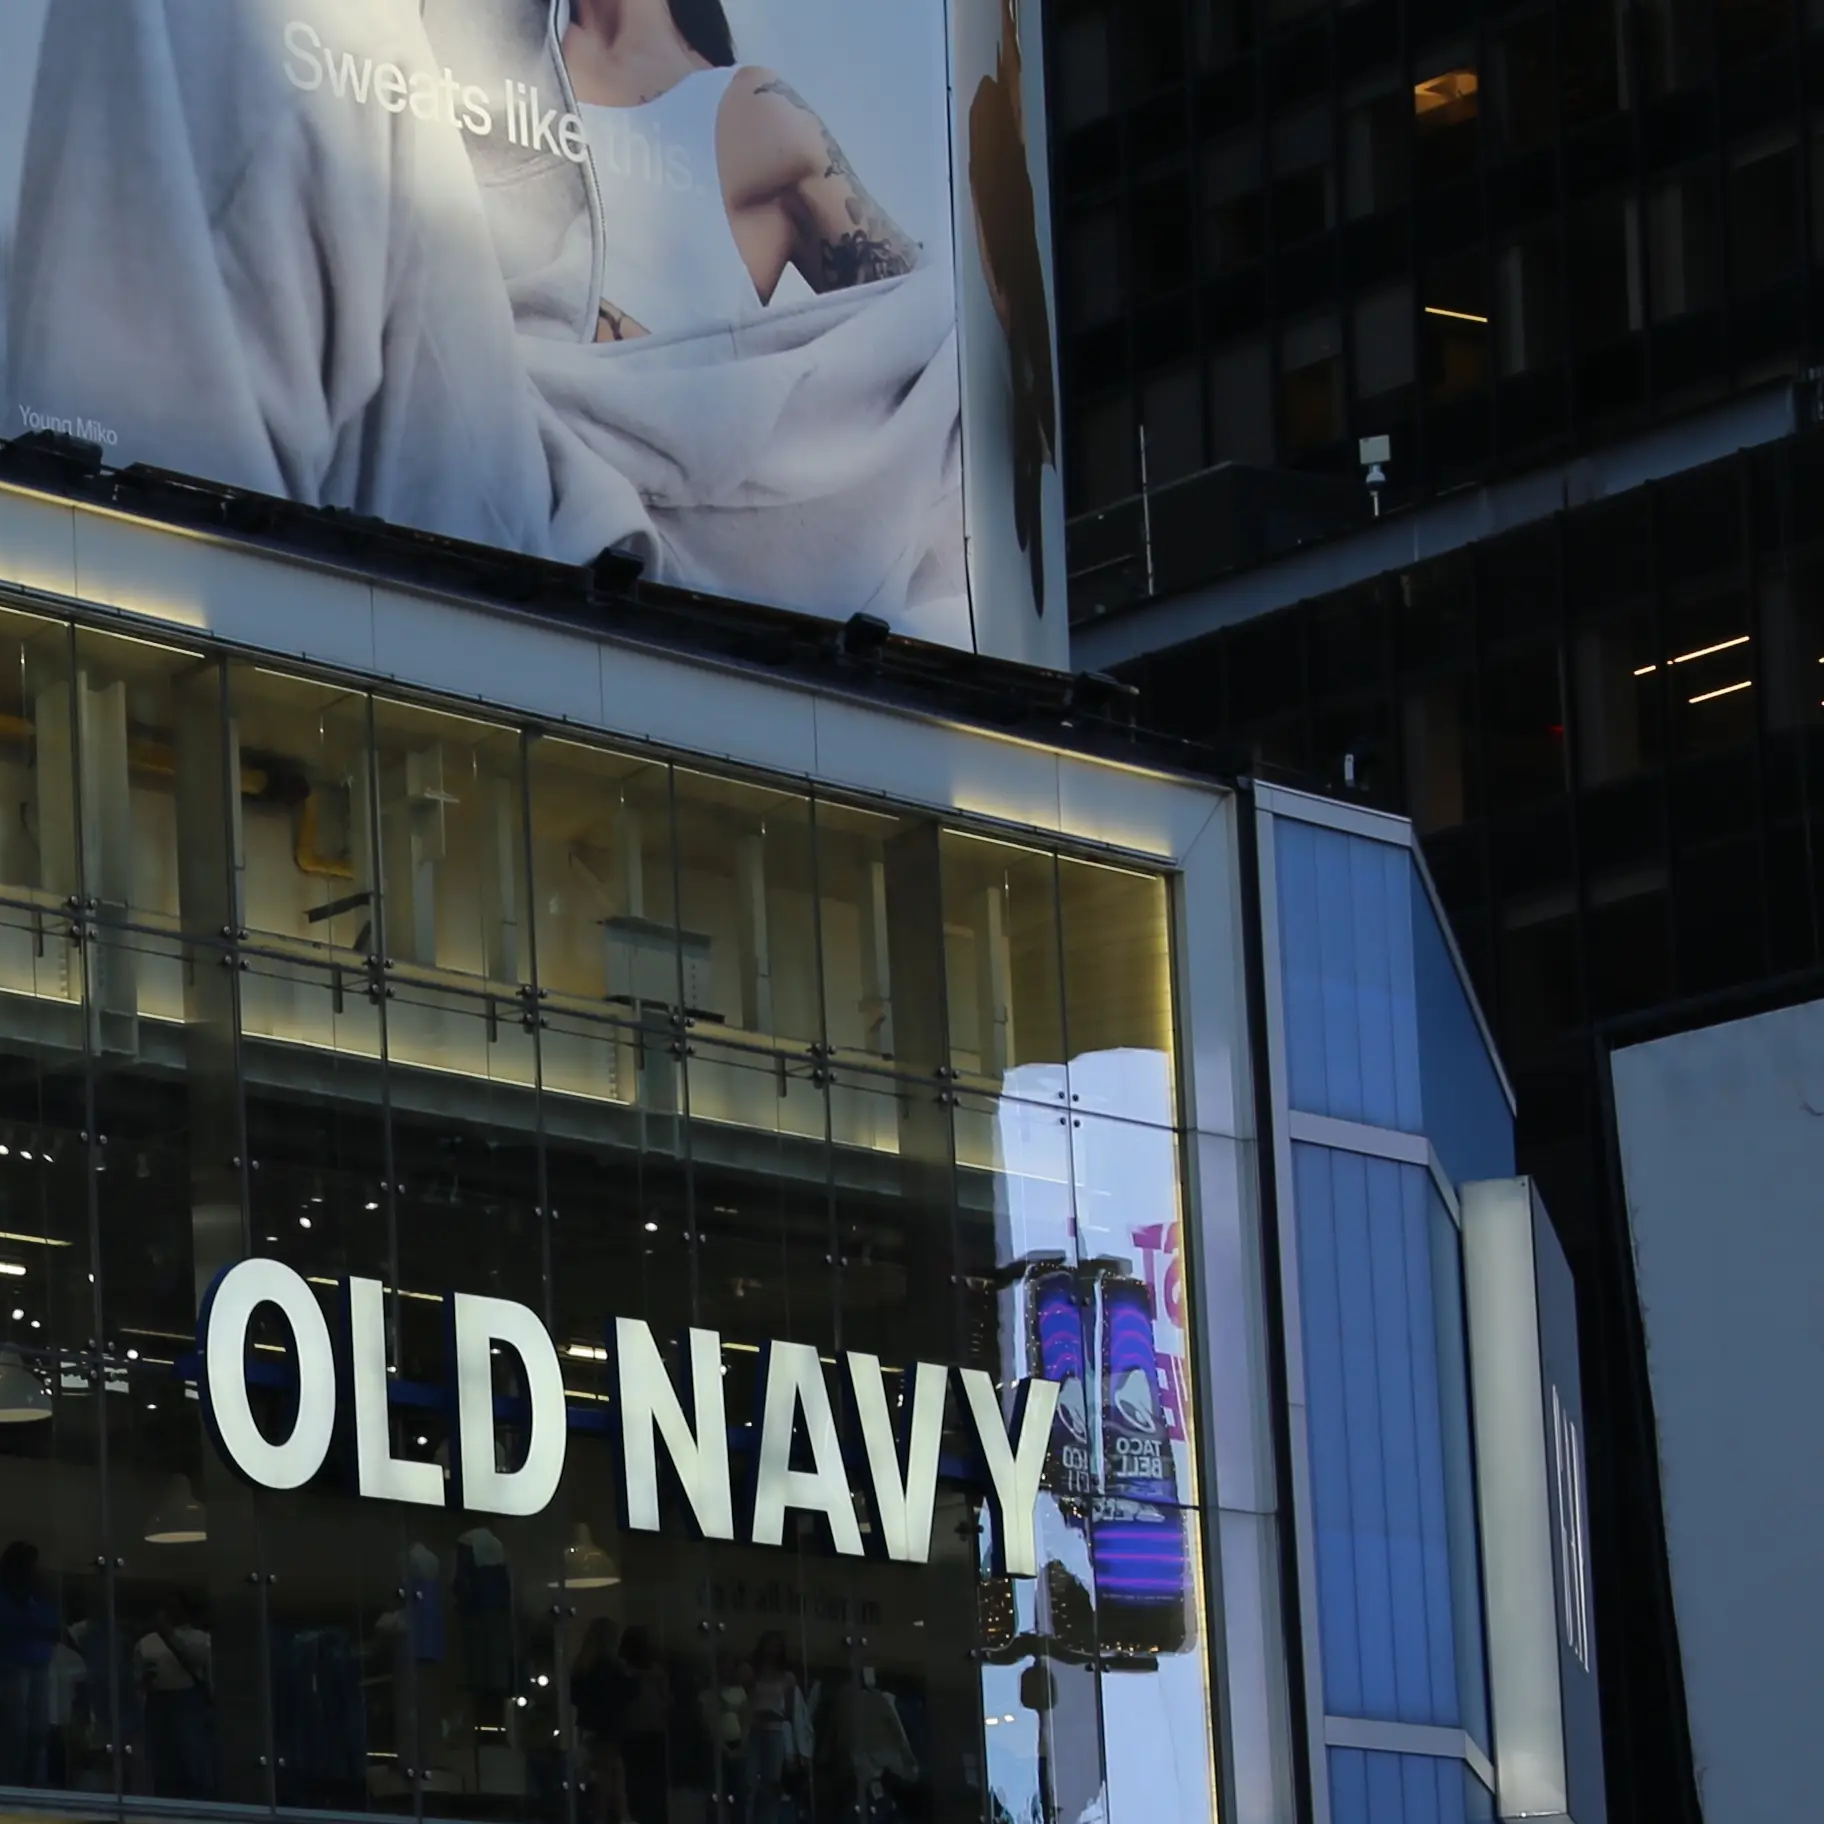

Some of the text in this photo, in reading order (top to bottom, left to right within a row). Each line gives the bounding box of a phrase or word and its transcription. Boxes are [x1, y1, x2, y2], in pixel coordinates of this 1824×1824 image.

[283, 19, 492, 138] Sweats
[503, 77, 590, 163] like
[202, 1257, 569, 1517] OLD
[614, 1317, 1061, 1579] NAVY
